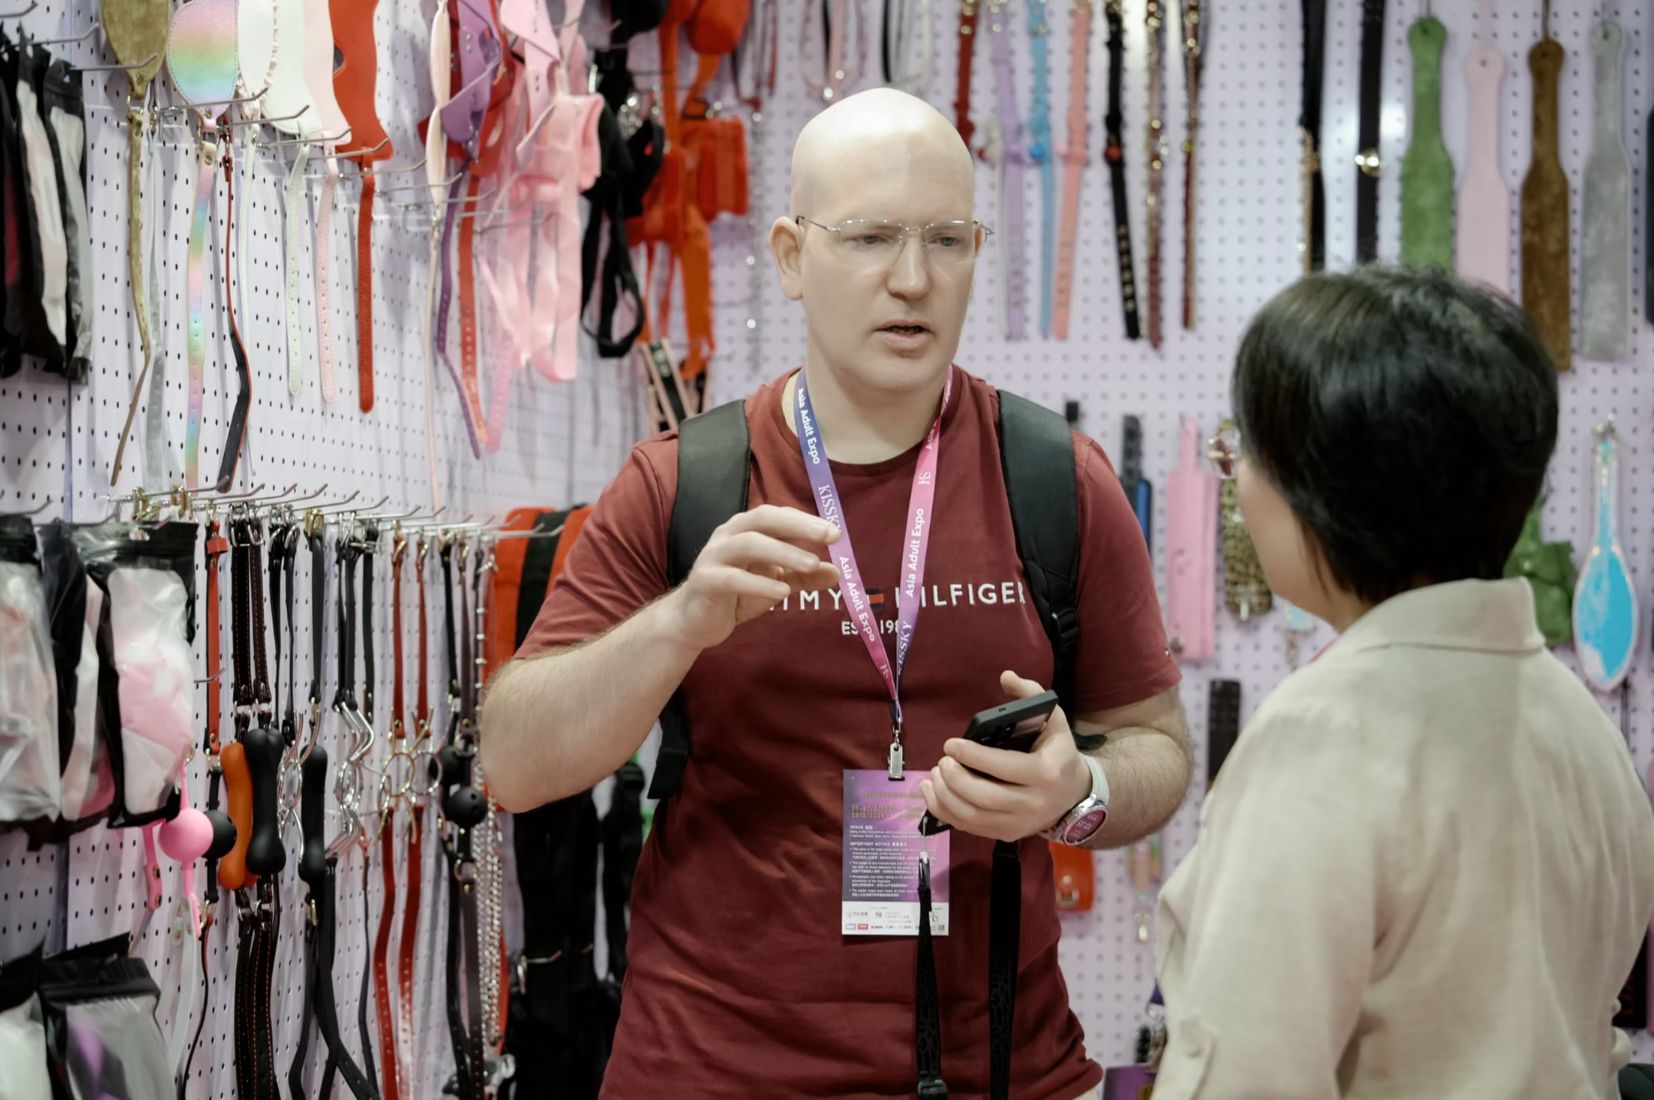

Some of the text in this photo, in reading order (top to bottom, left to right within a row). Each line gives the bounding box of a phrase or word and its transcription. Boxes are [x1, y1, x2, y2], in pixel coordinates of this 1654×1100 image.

[801, 409, 814, 437] Adult
[807, 437, 820, 465] Expo
[905, 508, 925, 598] Asia Adult Expo
[839, 556, 875, 642] Asia Adult Expo
